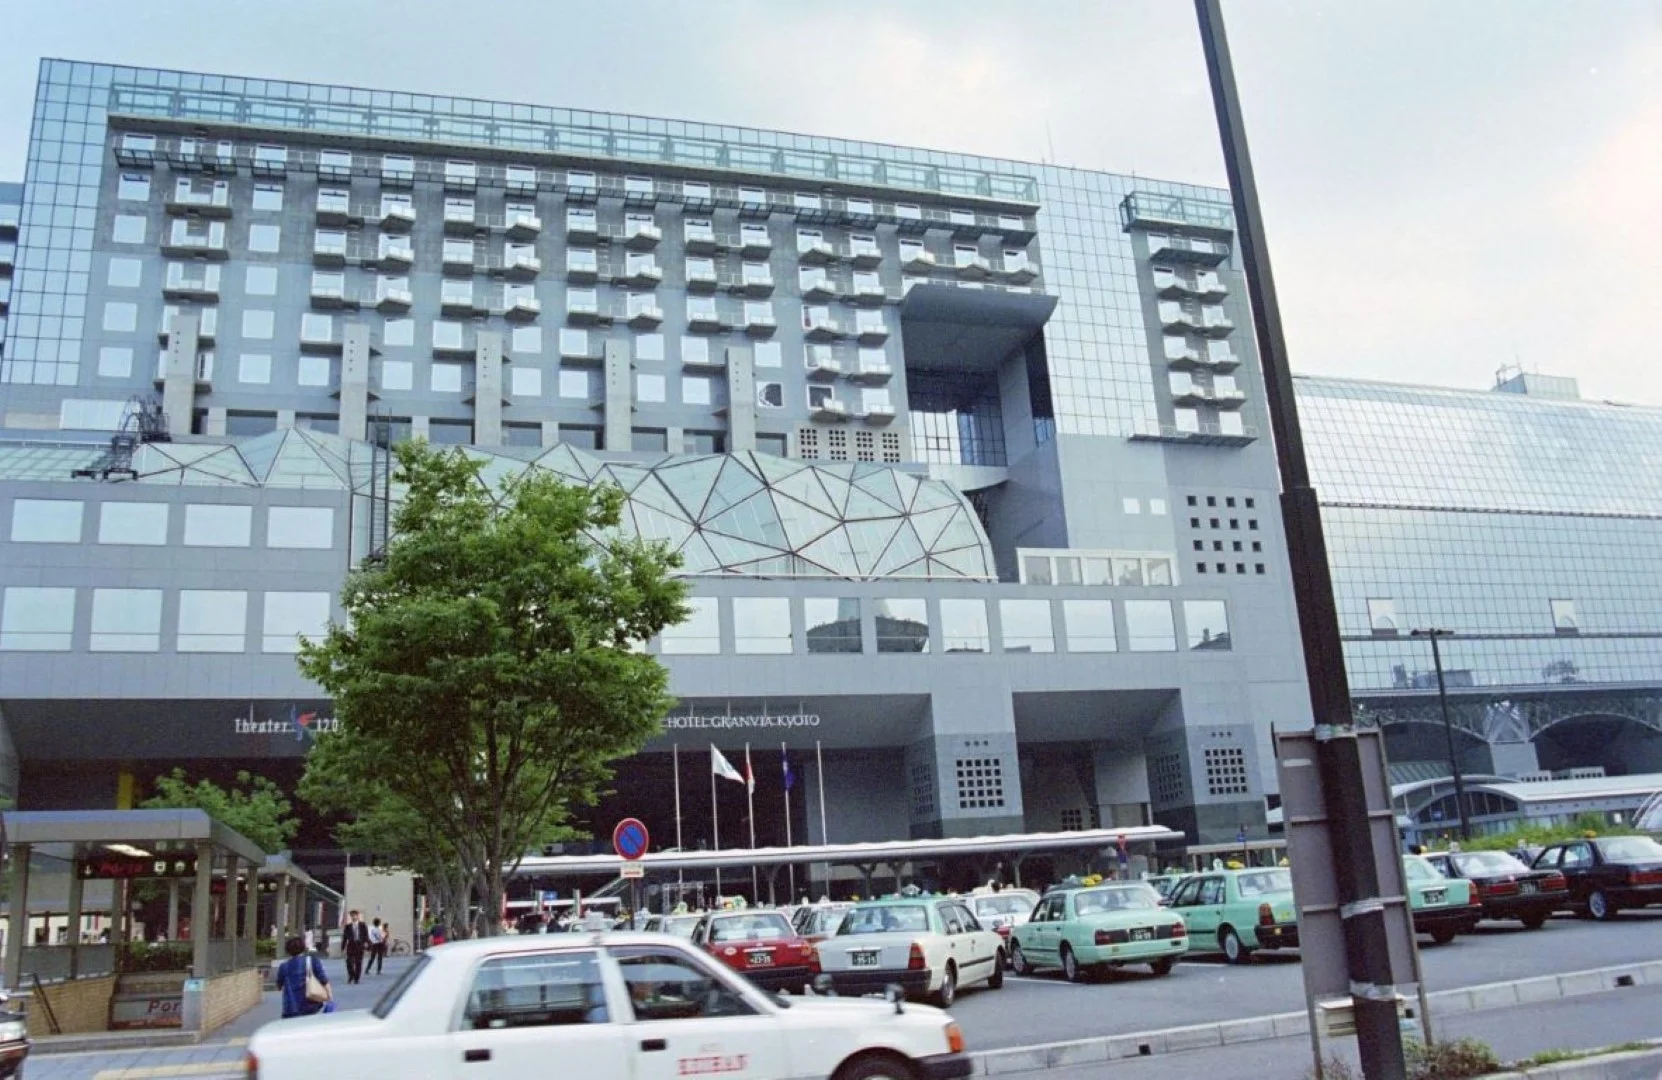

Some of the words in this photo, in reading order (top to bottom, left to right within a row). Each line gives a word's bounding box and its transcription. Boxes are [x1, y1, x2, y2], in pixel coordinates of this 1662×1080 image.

[235, 718, 289, 733] Theater
[668, 716, 707, 728] HOTEL
[711, 715, 772, 728] GRANVIA
[778, 714, 820, 728] KYOTO
